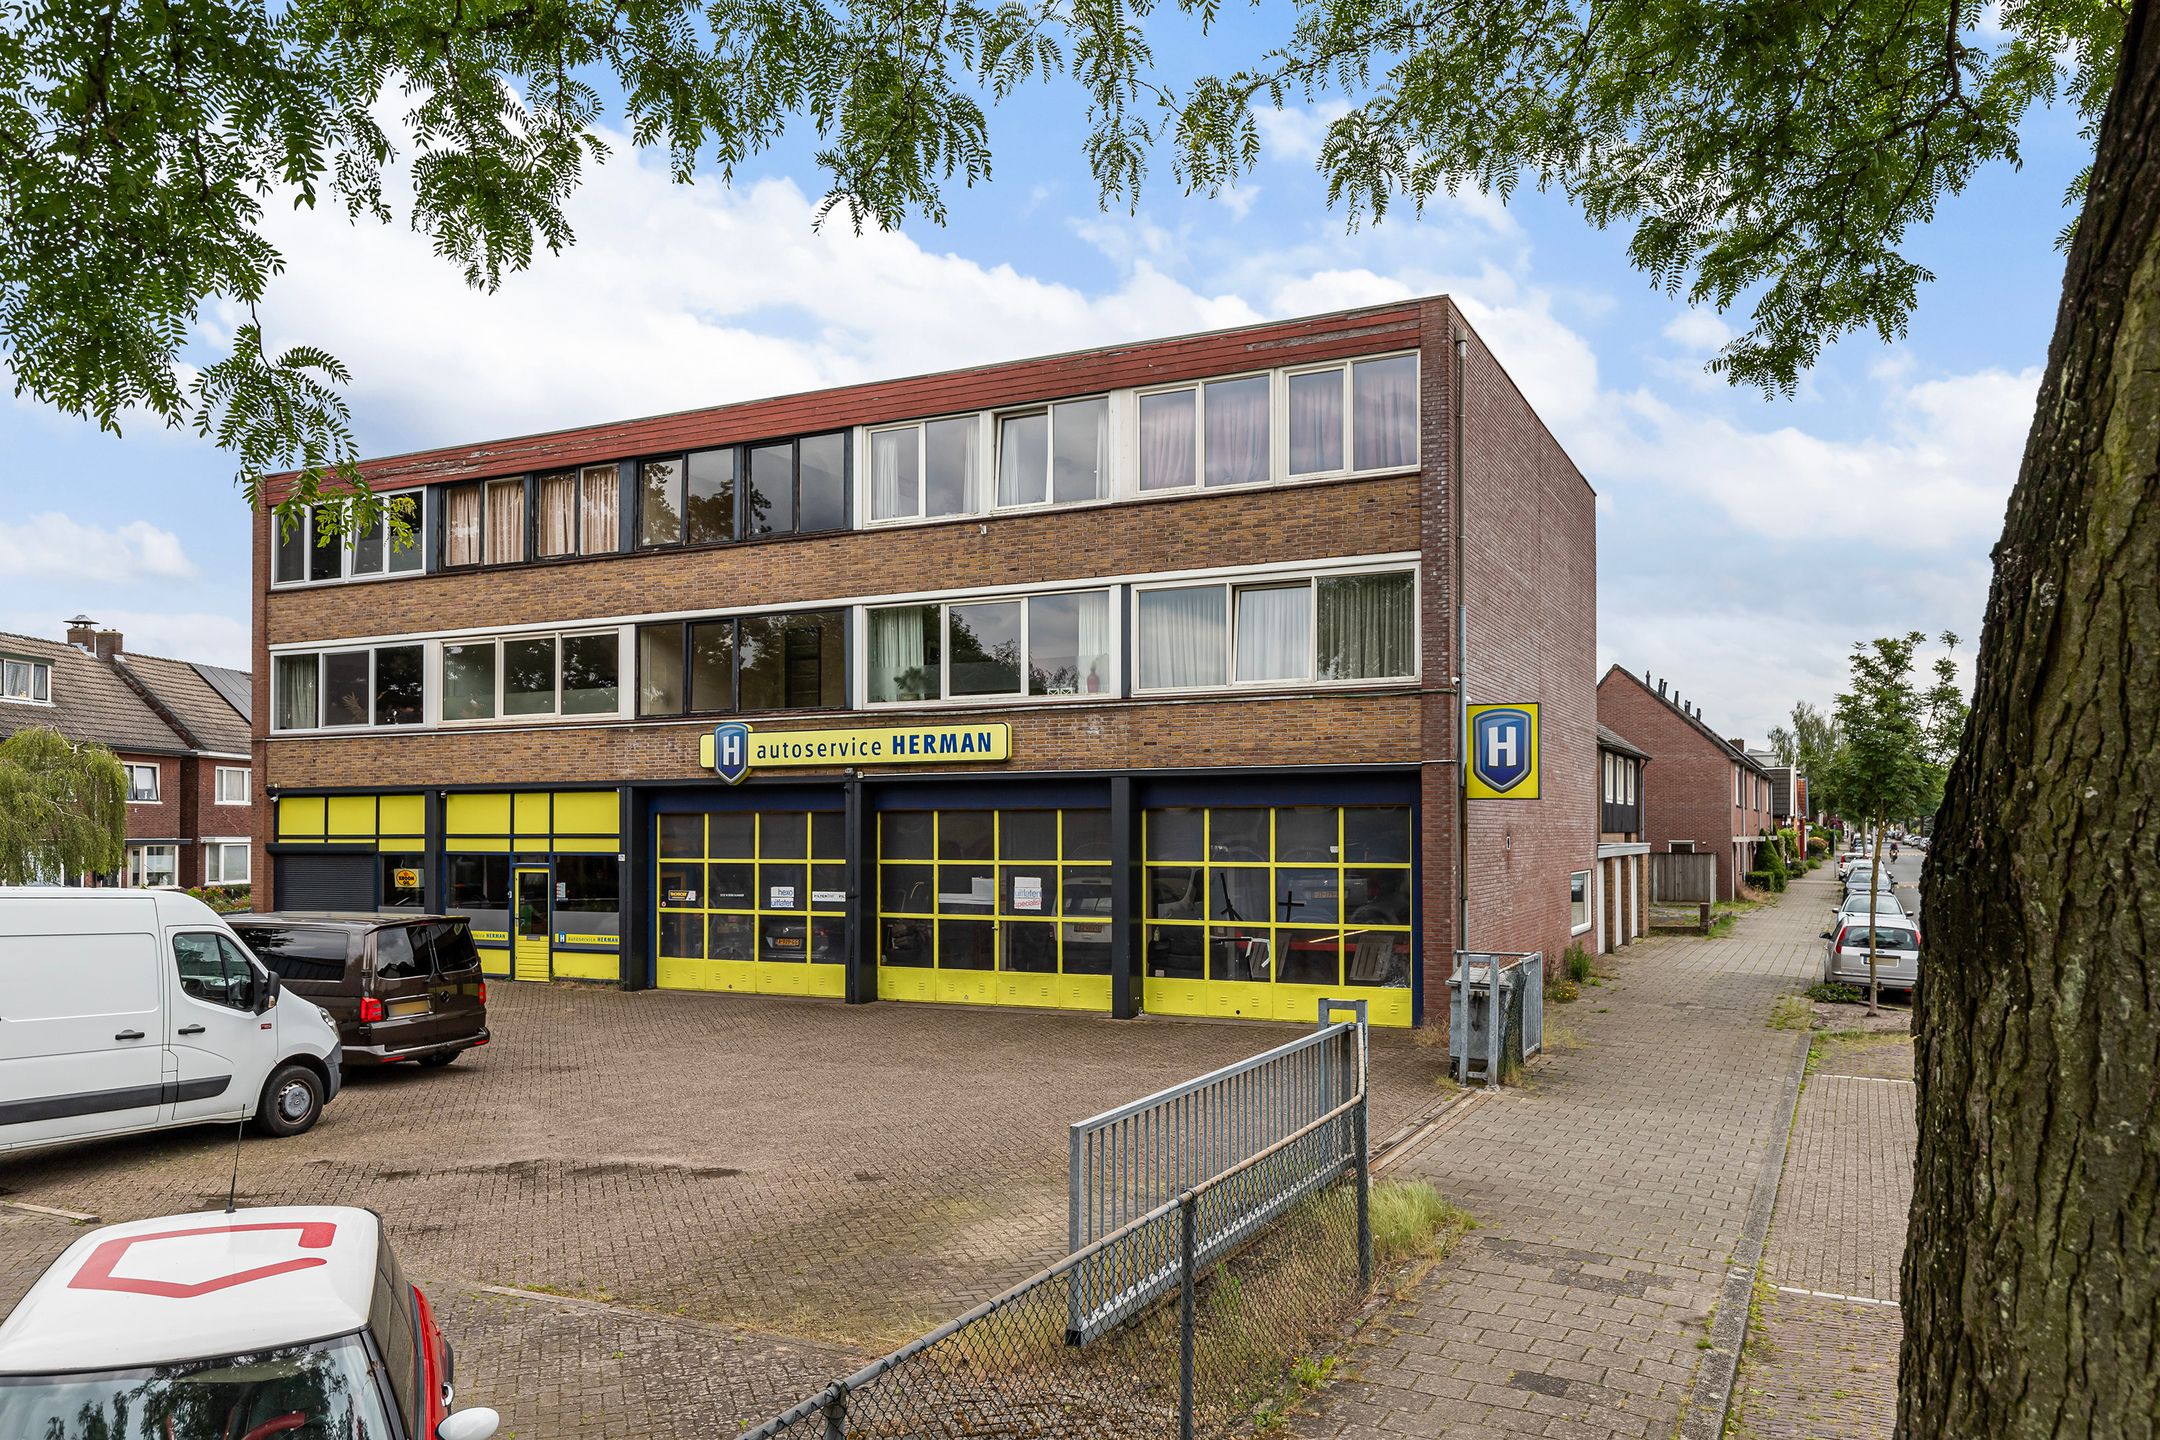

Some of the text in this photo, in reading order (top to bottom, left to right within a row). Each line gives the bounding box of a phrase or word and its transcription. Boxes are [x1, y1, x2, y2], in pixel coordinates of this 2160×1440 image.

[722, 732, 991, 766] H autoservice HERMAN
[1488, 726, 1517, 767] H
